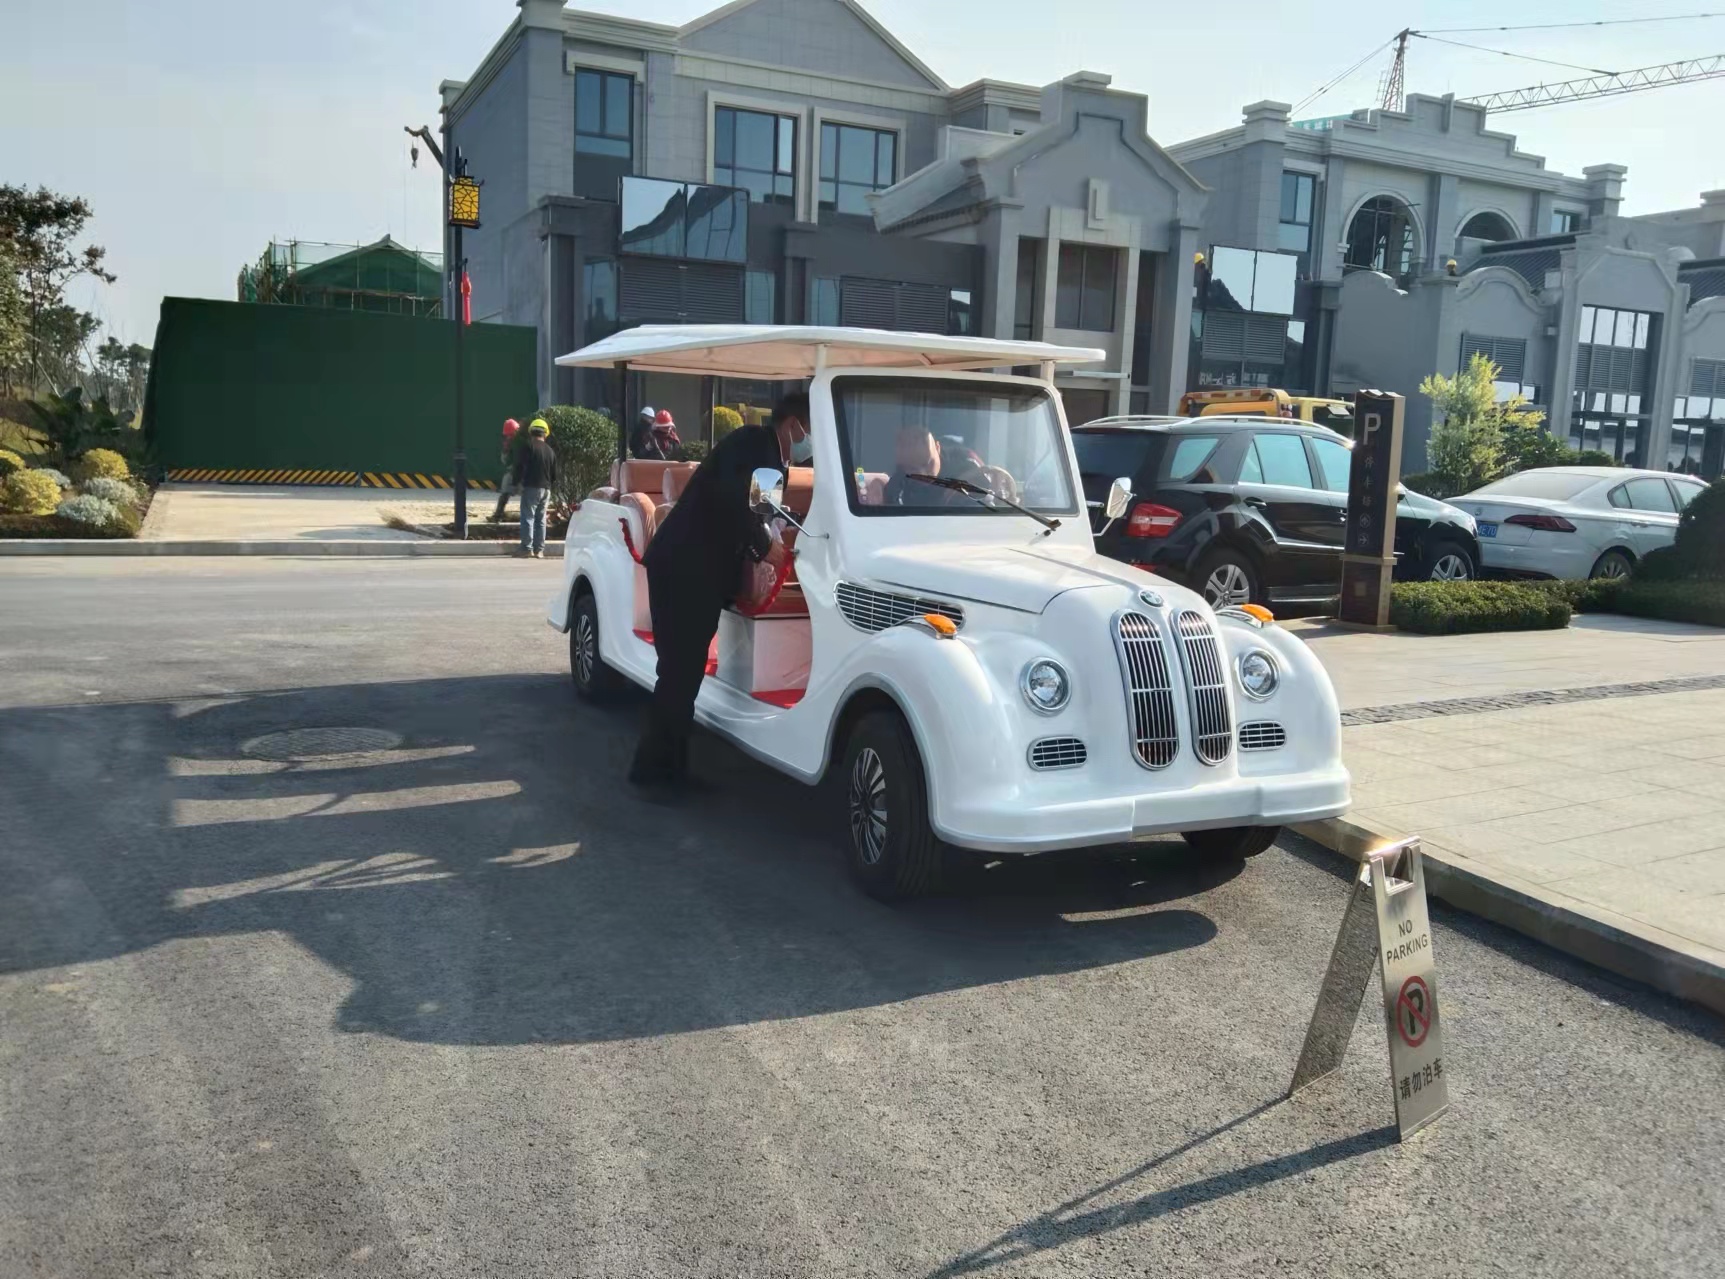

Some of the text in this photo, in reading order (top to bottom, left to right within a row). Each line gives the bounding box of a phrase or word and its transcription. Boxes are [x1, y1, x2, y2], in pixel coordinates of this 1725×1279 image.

[1363, 413, 1381, 446] P
[1398, 919, 1413, 937] NO
[1386, 933, 1428, 965] PARKING
[1399, 1057, 1443, 1101] 请勿泊车
